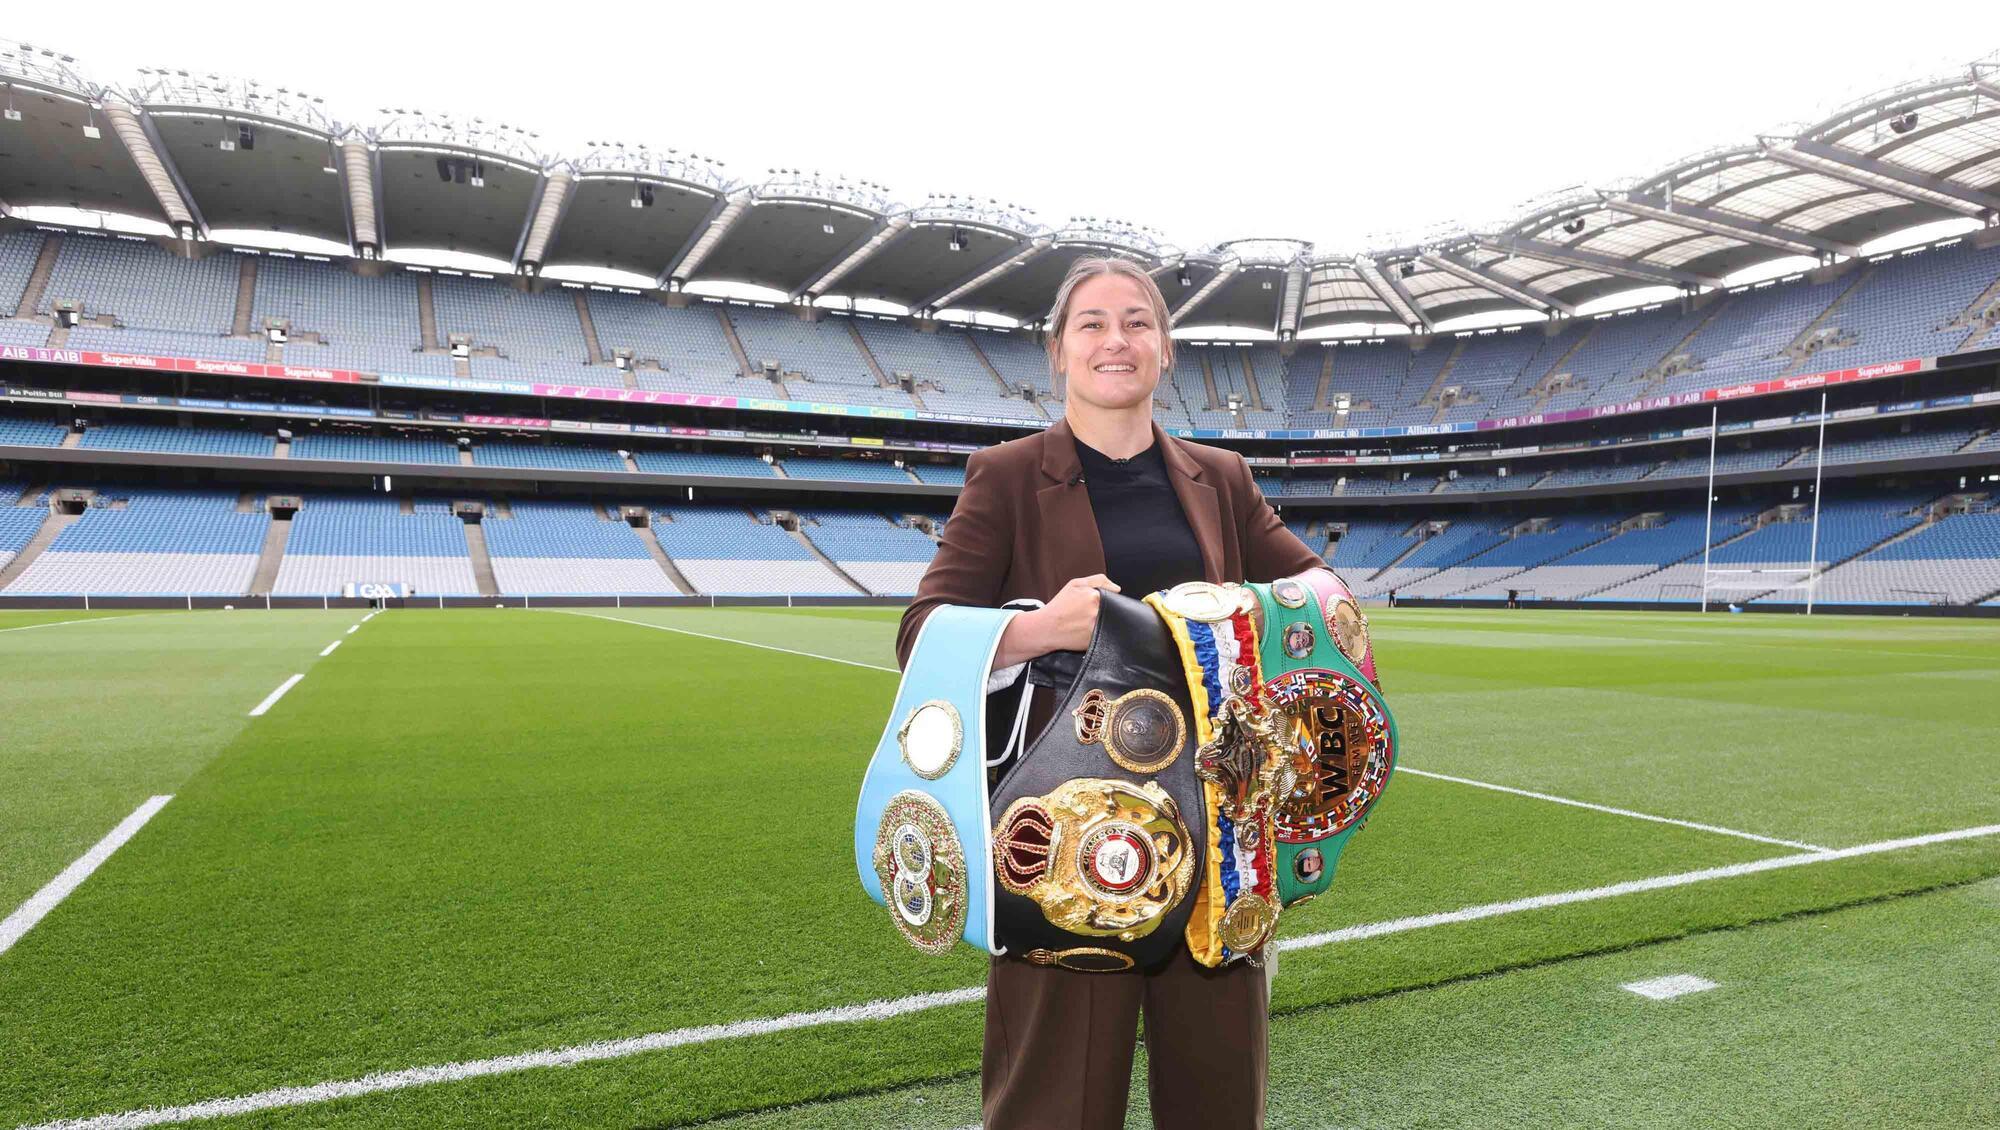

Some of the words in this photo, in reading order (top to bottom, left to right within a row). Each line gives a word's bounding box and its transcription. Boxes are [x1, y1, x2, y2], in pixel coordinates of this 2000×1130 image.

[2, 347, 29, 359] AIB
[53, 350, 79, 362] AIB
[101, 353, 156, 367] SuperValu
[195, 360, 247, 373] SuperValu
[1857, 362, 1904, 378] SuperValu
[284, 367, 333, 380] SuperValu
[1783, 375, 1825, 389] SuperValu
[10, 388, 21, 396] An
[1717, 385, 1755, 398] SuperValu
[1654, 397, 1670, 408] AIB
[1684, 393, 1700, 403] AIB
[1601, 405, 1616, 415] AIB
[1626, 401, 1641, 412] AIB
[1503, 417, 1517, 427] AIB
[1529, 414, 1543, 424] AIB
[1221, 430, 1253, 439] Allianz
[1313, 430, 1345, 439] Allianz
[1407, 424, 1439, 435] Allianz
[360, 583, 397, 598] GAA
[1315, 707, 1349, 801] WBC
[1350, 721, 1361, 776] FEMALE
